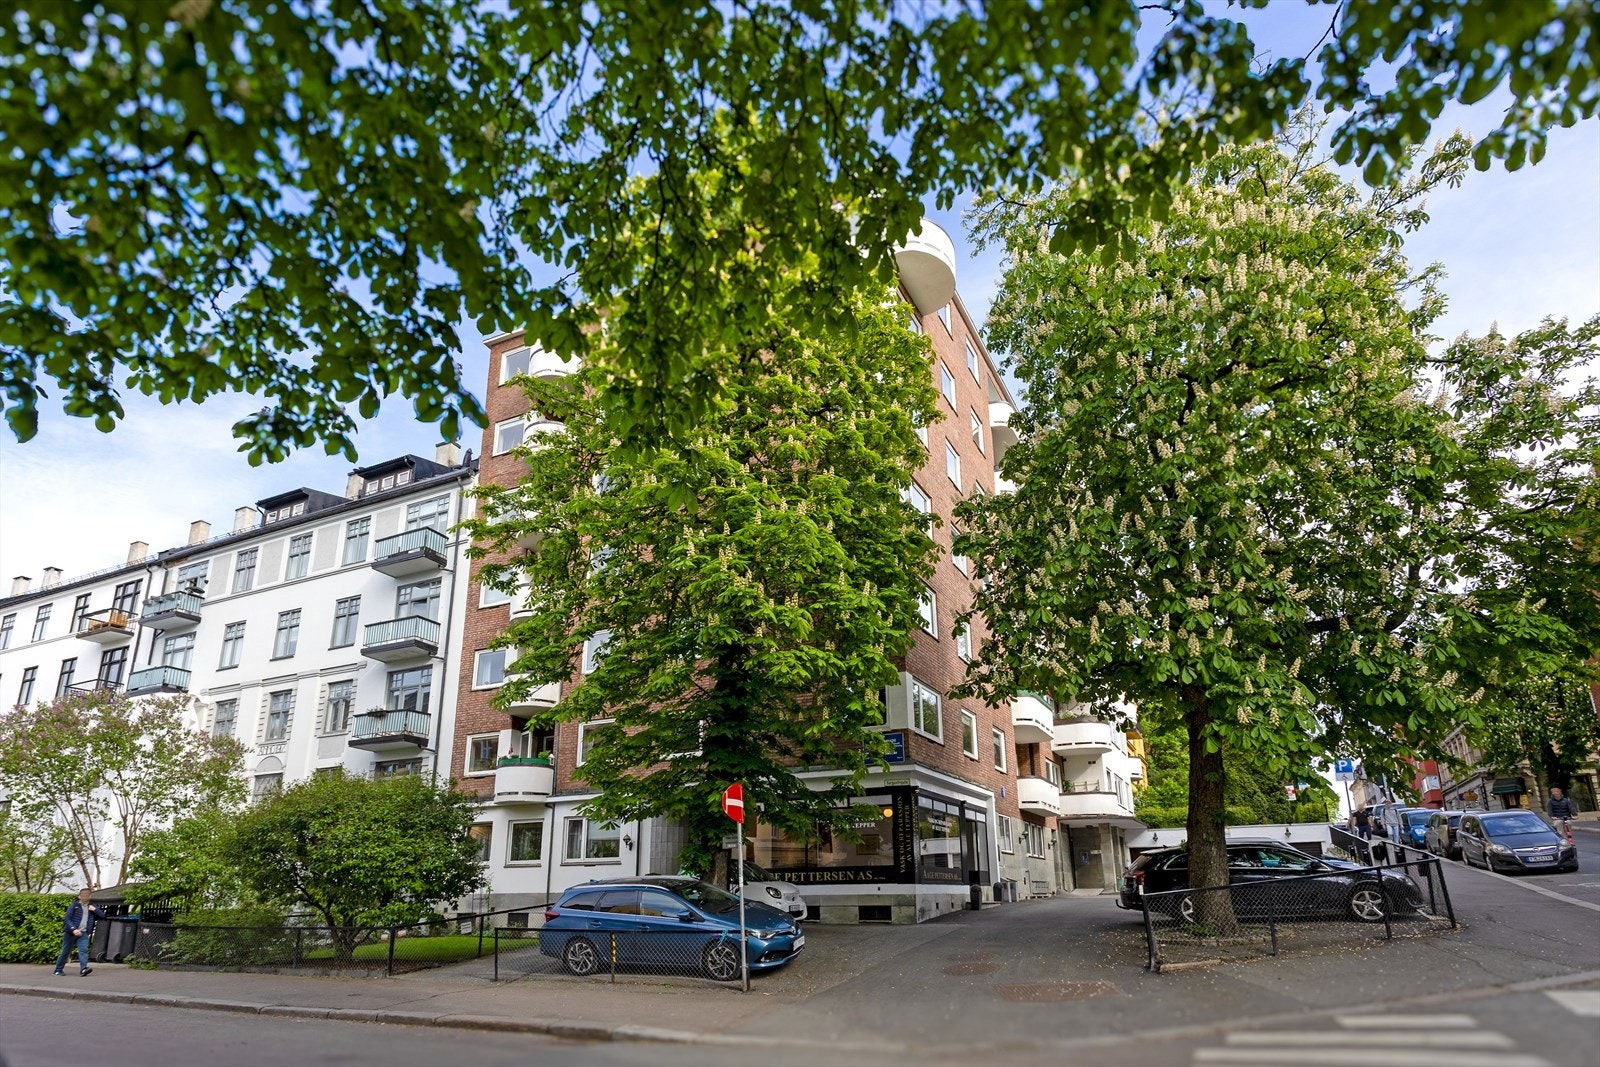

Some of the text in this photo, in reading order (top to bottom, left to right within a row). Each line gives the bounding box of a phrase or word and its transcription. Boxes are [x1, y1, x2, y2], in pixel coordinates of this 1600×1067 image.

[1338, 760, 1348, 771] P
[897, 796, 905, 841] REPARASJON
[898, 842, 905, 854] OG
[857, 869, 873, 881] AS
